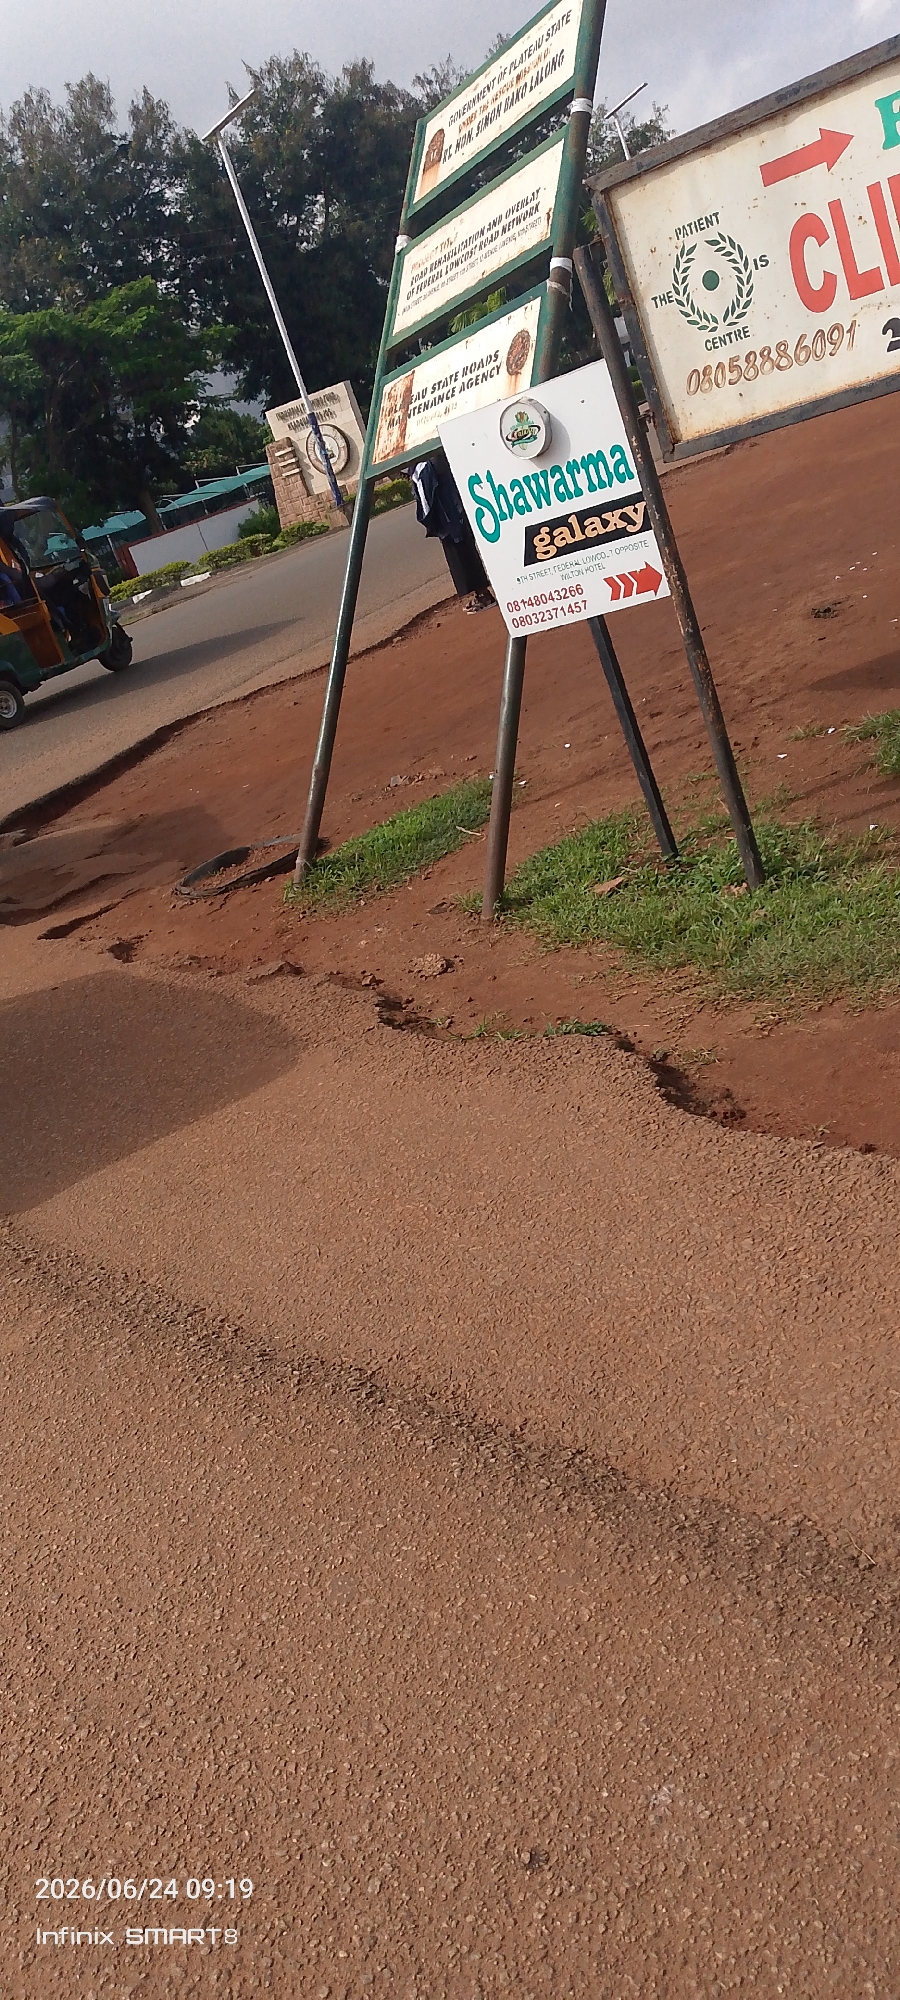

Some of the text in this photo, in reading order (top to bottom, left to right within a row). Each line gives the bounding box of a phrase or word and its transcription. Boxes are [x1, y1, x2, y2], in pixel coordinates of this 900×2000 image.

[509, 34, 544, 75] PLATEAU
[545, 9, 572, 42] STATE
[529, 49, 564, 93] LALONG
[406, 201, 540, 300] OF FEDERAL LOWCOST ROAD NETWORK
[410, 267, 427, 286] ROAD
[487, 214, 502, 232] AND
[505, 187, 541, 219] OVERLAY
[674, 211, 720, 241] PATIENT
[651, 254, 770, 309] THE IS
[686, 320, 856, 396] 08058886091
[705, 326, 751, 352] CENTRE
[387, 386, 457, 430] MANTENANCE
[459, 359, 502, 394] AGENCY
[430, 371, 459, 394] STATE
[462, 350, 499, 378] ROADS
[467, 444, 635, 543] Shawarma
[533, 501, 646, 560] galaxy
[507, 583, 584, 613] 08148043266
[560, 562, 606, 581] WILTON HOTEL
[512, 600, 588, 628] 08032371457
